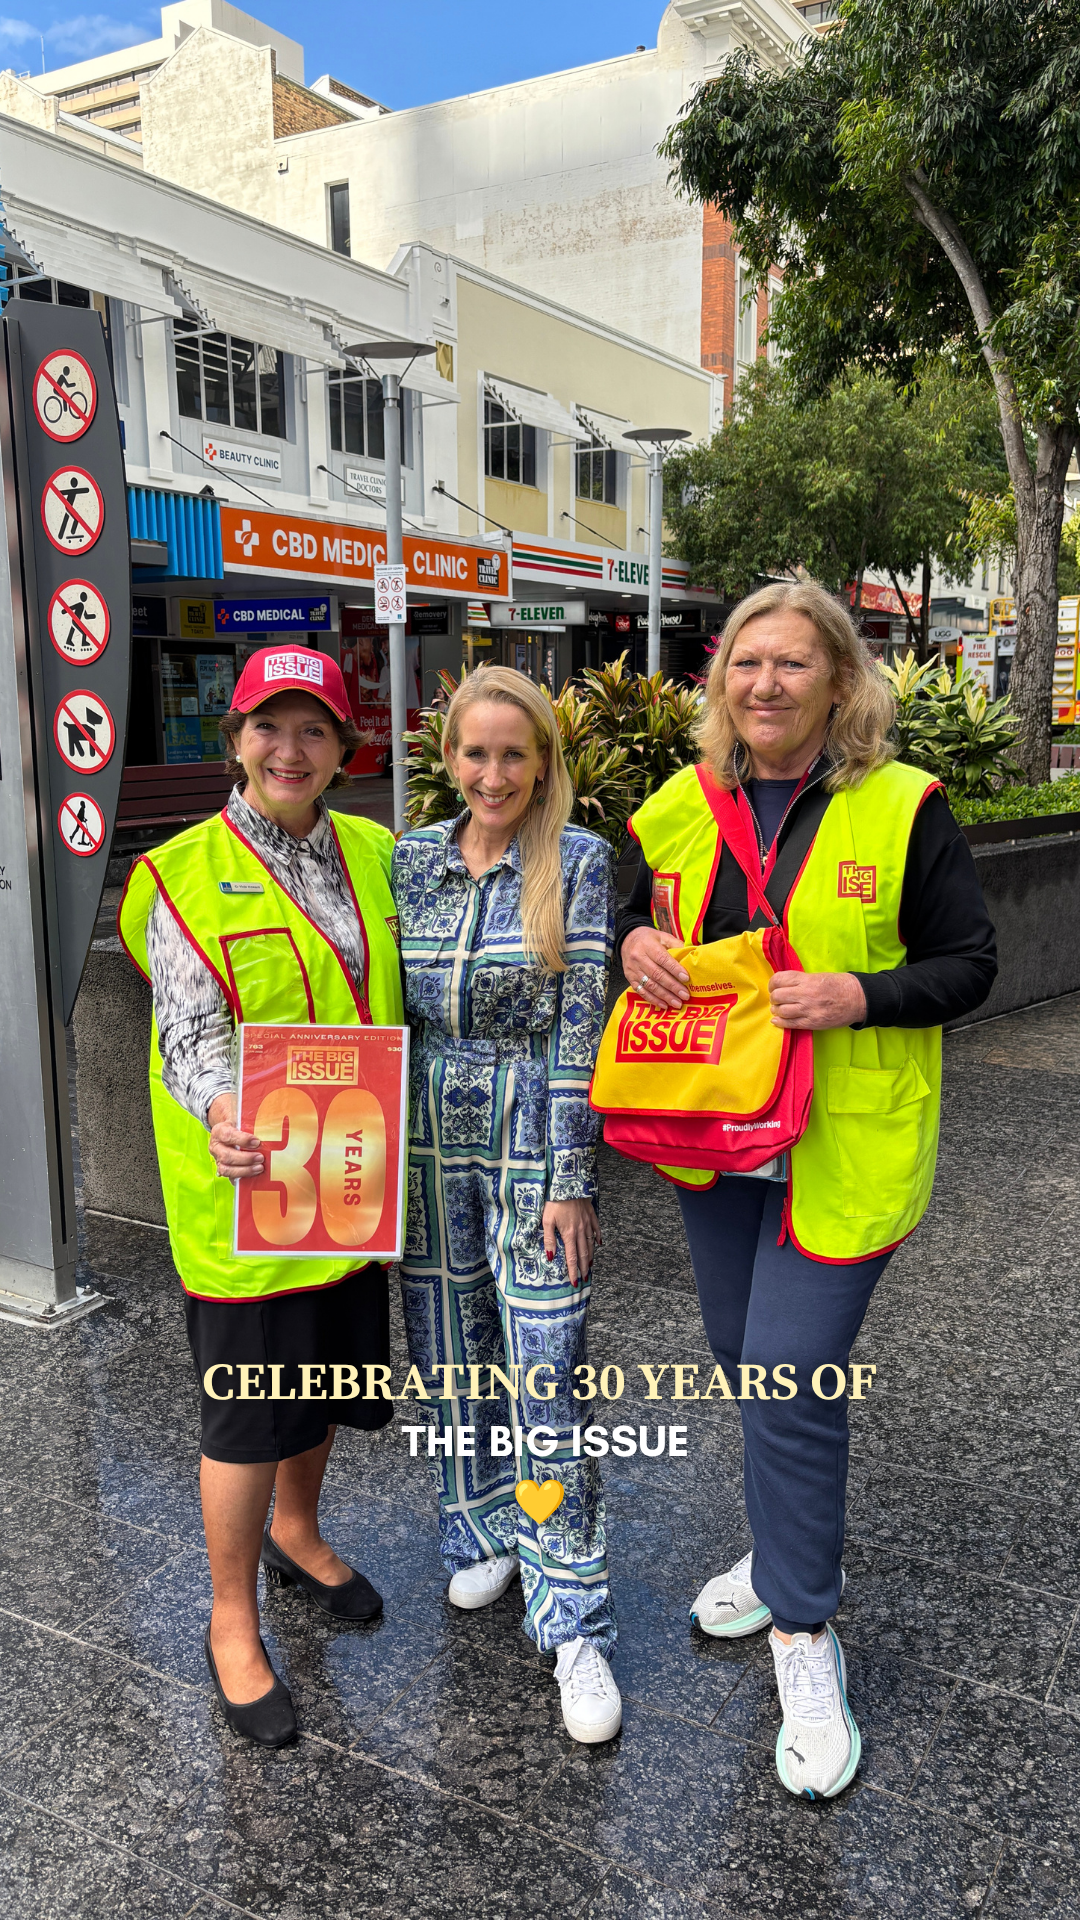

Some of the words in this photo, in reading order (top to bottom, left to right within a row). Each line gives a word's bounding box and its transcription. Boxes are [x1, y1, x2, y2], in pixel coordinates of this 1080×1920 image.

[220, 449, 252, 465] BEAUTY
[253, 456, 279, 470] CLINIC
[350, 472, 369, 483] TRAVEL
[356, 482, 382, 494] DOCTORS
[272, 529, 318, 560] CBD
[323, 536, 408, 572] MEDIC
[413, 551, 468, 580] CLINIC
[608, 558, 649, 586] 7-ELEVE
[478, 574, 498, 584] CLINIC
[233, 610, 255, 622] CBD
[257, 608, 305, 621] MEDICAL
[269, 656, 295, 665] THE
[297, 656, 319, 668] BIG
[268, 663, 320, 680] ISSUE
[360, 716, 374, 727] Feel
[375, 716, 380, 726] it
[381, 715, 389, 726] all
[166, 723, 186, 733] FOR
[167, 735, 197, 746] LEASE
[689, 982, 736, 993] themselves.
[635, 1002, 680, 1020] THE
[680, 1005, 726, 1020] BIG
[623, 1019, 716, 1052] ISSUE
[293, 1052, 324, 1061] THE
[326, 1052, 353, 1062] BIG
[292, 1062, 353, 1080] ISSUE
[722, 1120, 781, 1132] #ProudlyWorking
[252, 1087, 386, 1246] 30
[344, 1129, 363, 1206] YEARS
